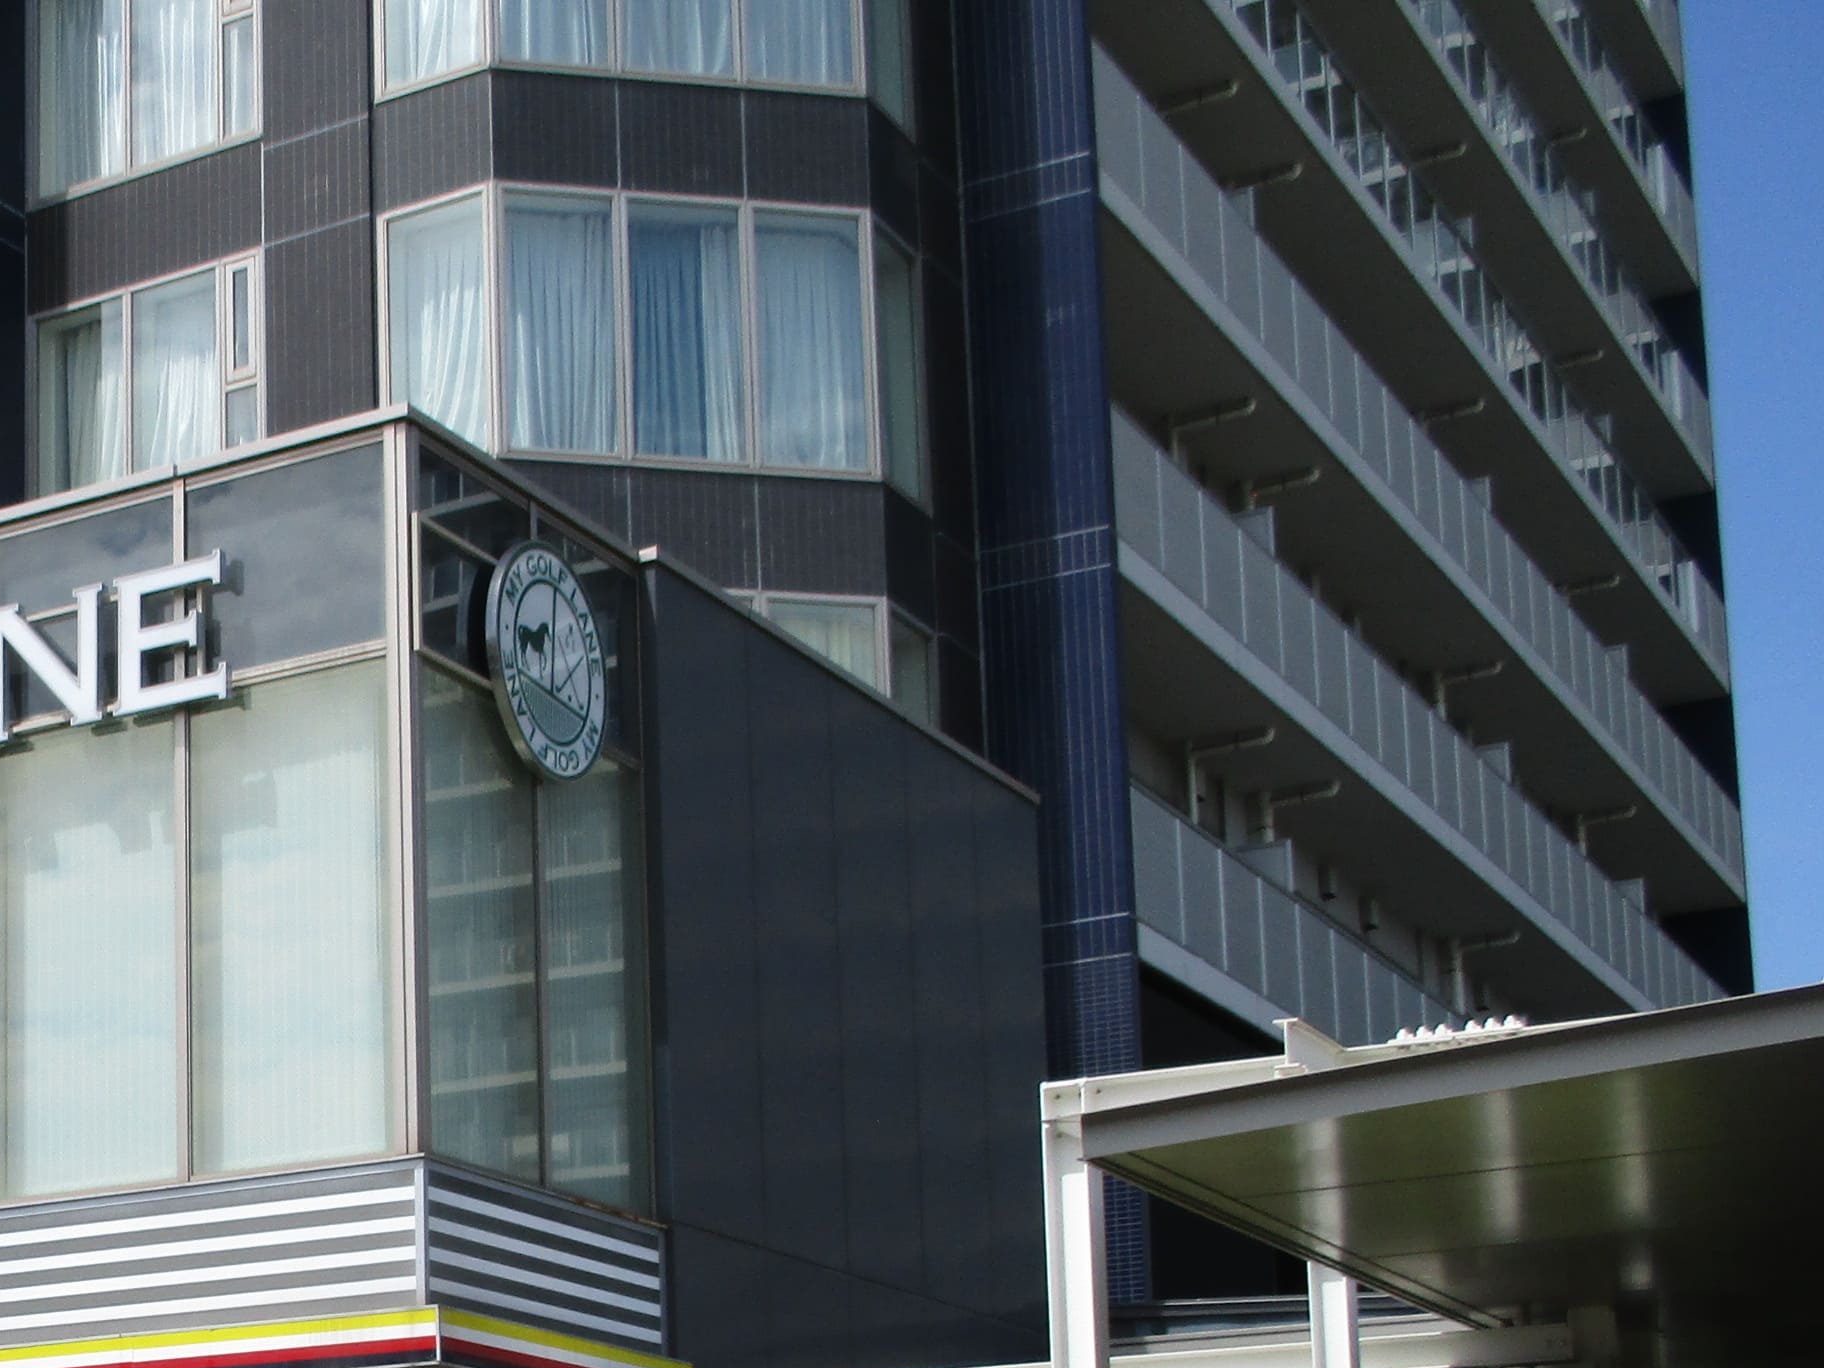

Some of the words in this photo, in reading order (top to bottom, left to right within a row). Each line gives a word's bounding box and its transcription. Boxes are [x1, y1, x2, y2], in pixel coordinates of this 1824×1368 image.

[505, 563, 524, 603] MY
[526, 555, 570, 587] GOLF
[571, 587, 602, 678] LANE
[539, 743, 580, 771] GOLF
